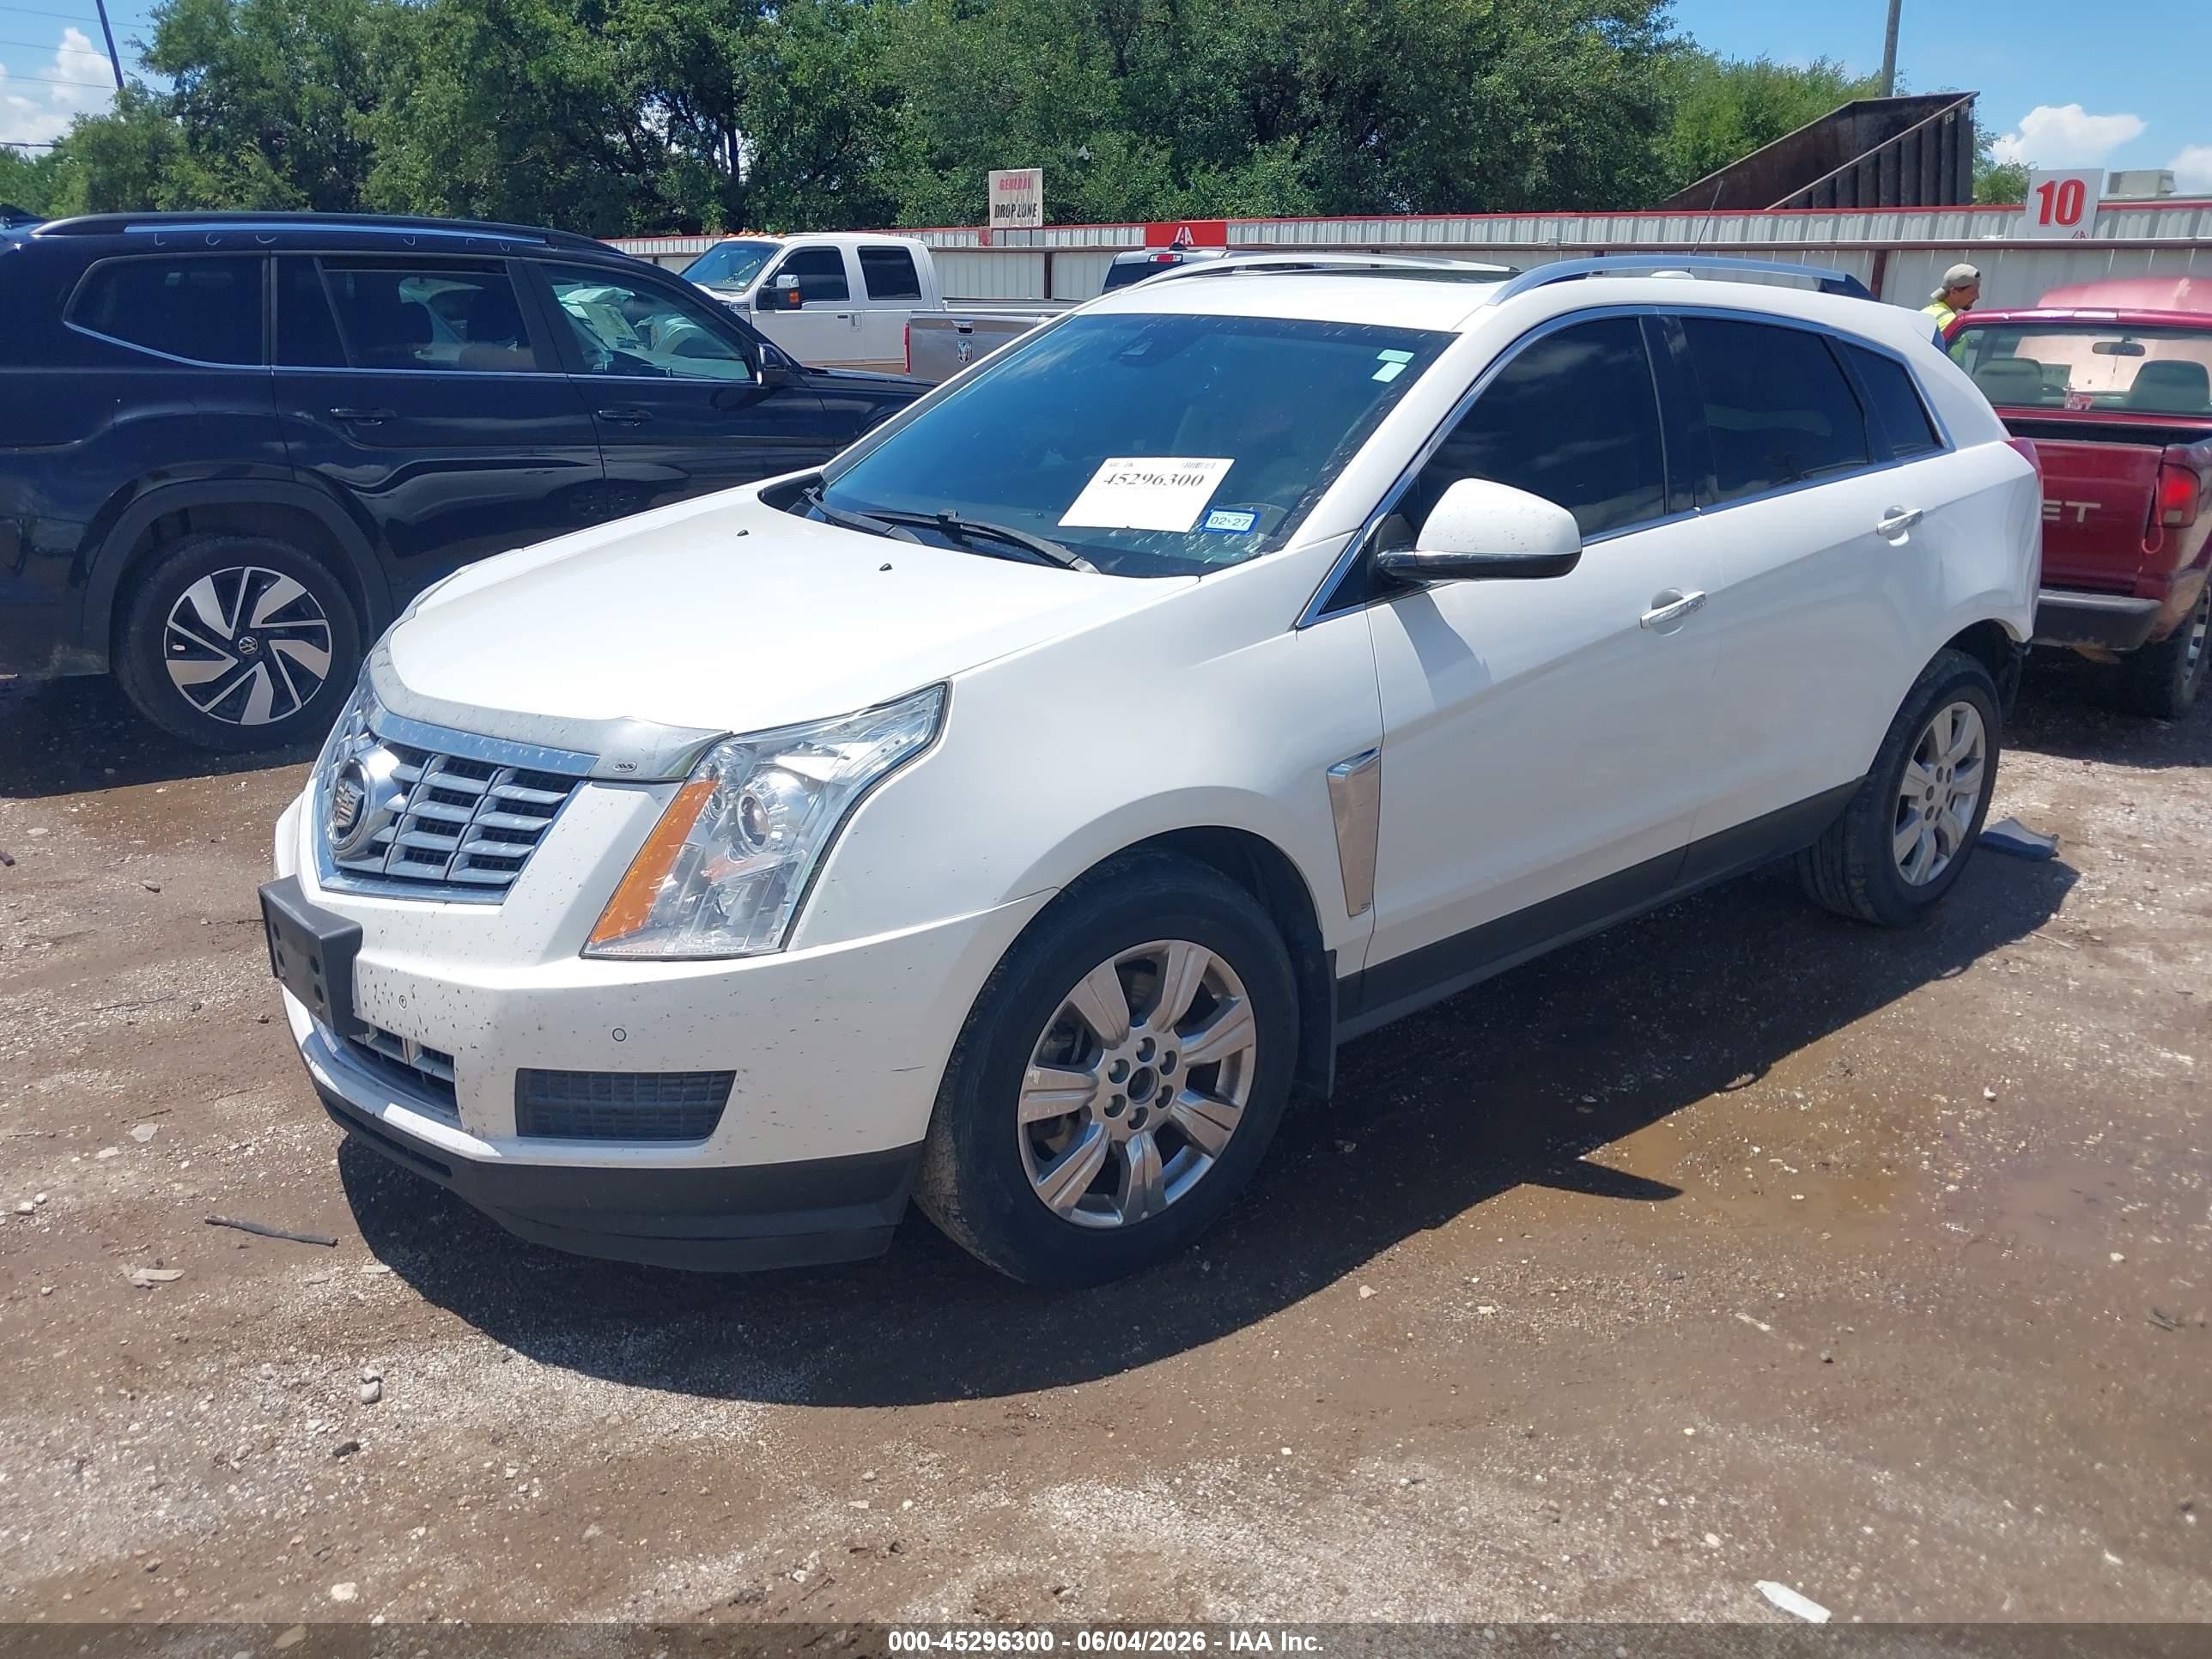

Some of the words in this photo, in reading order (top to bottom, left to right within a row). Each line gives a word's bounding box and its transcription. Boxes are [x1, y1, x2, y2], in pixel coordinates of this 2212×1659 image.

[2035, 178, 2086, 227] 10
[994, 203, 1016, 219] DROP
[1103, 472, 1206, 487] 45296300
